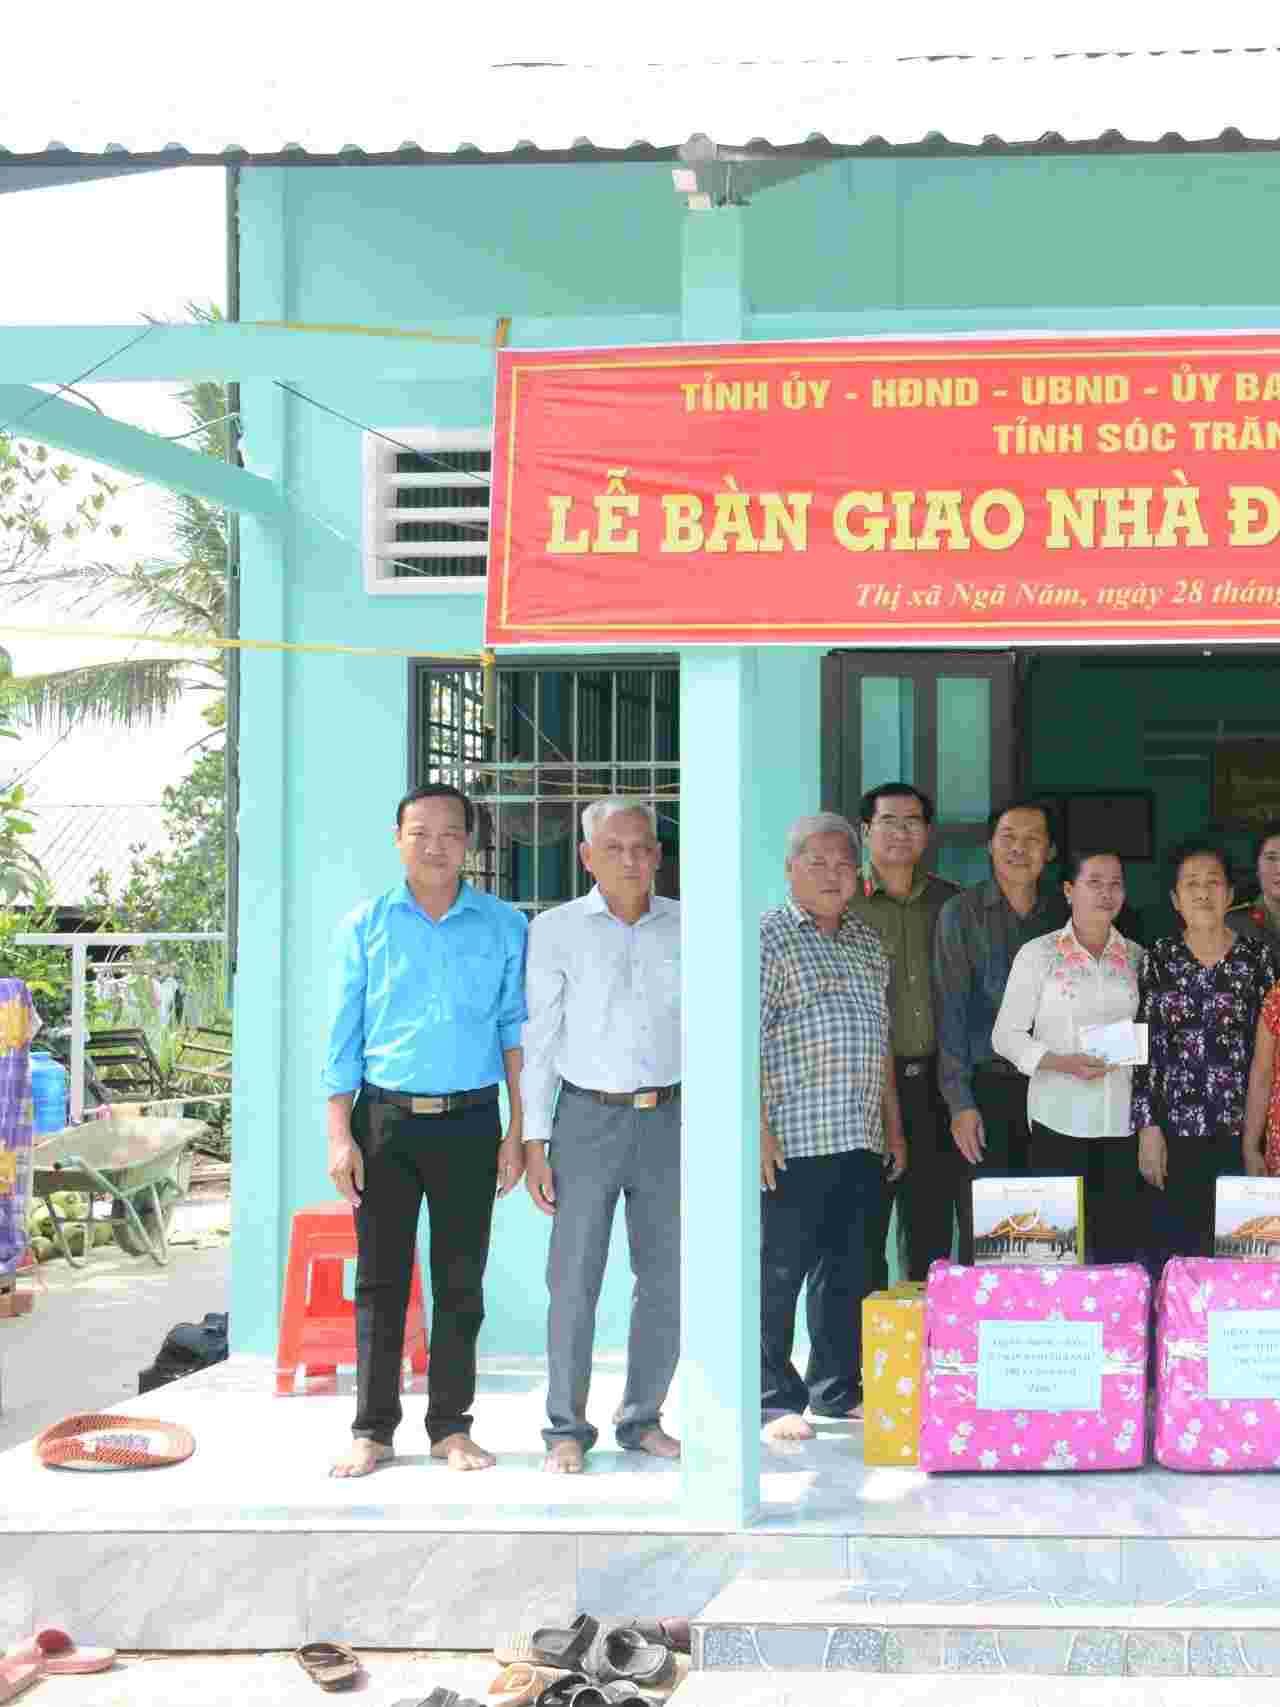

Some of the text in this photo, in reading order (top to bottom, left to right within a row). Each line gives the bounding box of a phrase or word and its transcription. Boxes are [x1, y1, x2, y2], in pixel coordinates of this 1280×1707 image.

[681, 371, 768, 411] TỈNH
[782, 372, 831, 409] ỦY
[871, 377, 979, 407] HĐND
[1021, 375, 1128, 405] UBND
[1171, 364, 1222, 401] ỦY
[992, 416, 1083, 455] TỈNH
[1096, 417, 1176, 453] SÓC
[545, 468, 641, 554] LỄ
[660, 474, 812, 553] BÀN
[832, 488, 1026, 553] GIAO
[1045, 468, 1209, 549] NHÀ
[856, 583, 903, 611] Thị
[907, 585, 944, 609] xã
[950, 583, 1008, 610] Ngã
[1015, 582, 1088, 608] Năm,
[1096, 581, 1165, 611] ngày
[1172, 577, 1205, 603] 28
